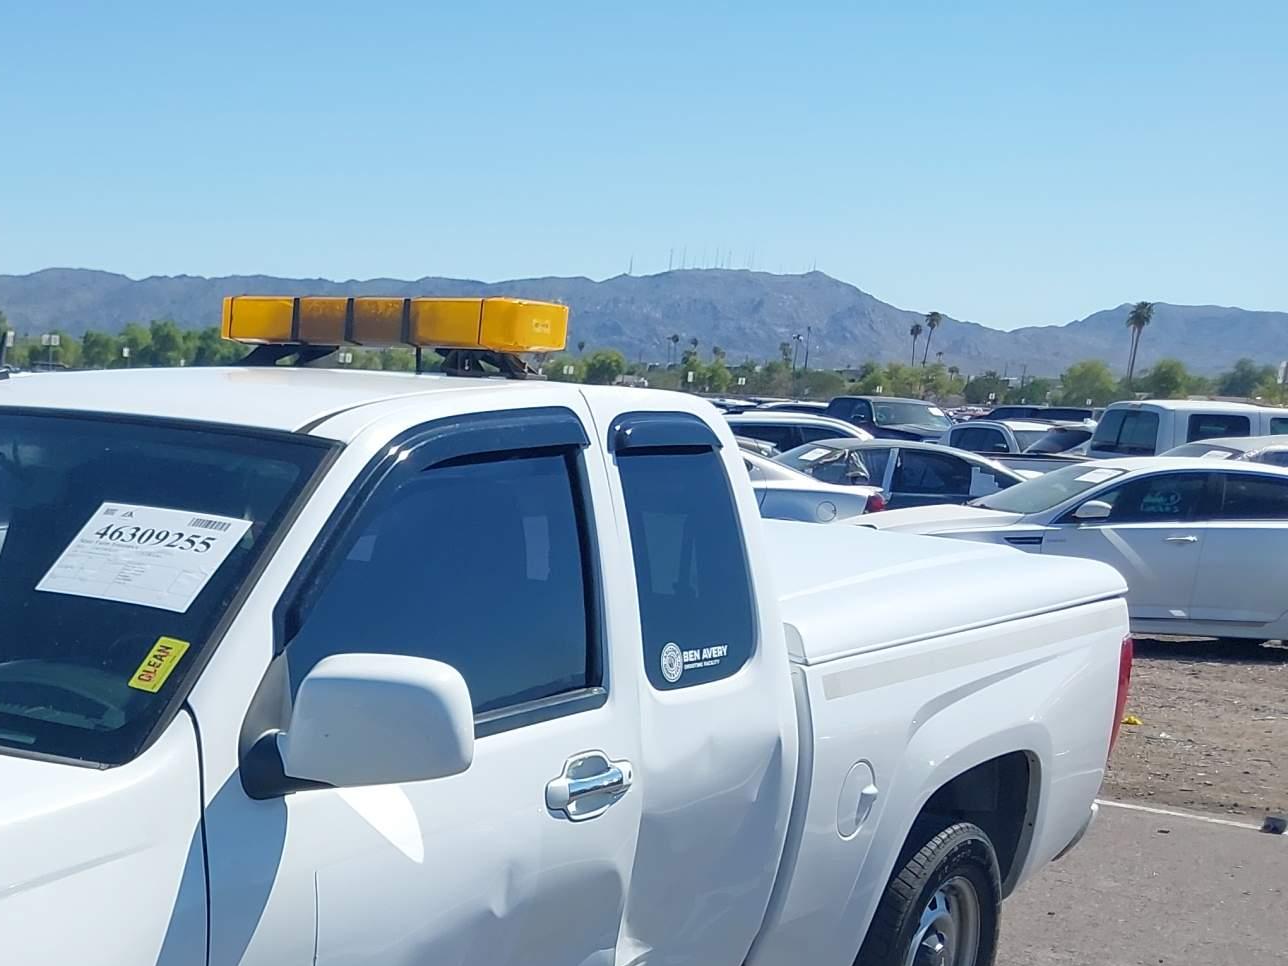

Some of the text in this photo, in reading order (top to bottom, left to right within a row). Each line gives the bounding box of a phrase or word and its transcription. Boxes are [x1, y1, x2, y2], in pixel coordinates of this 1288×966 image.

[95, 523, 218, 554] 46309255
[137, 645, 174, 682] CLEAN
[683, 649, 701, 662] BEN
[702, 645, 728, 659] AVERY
